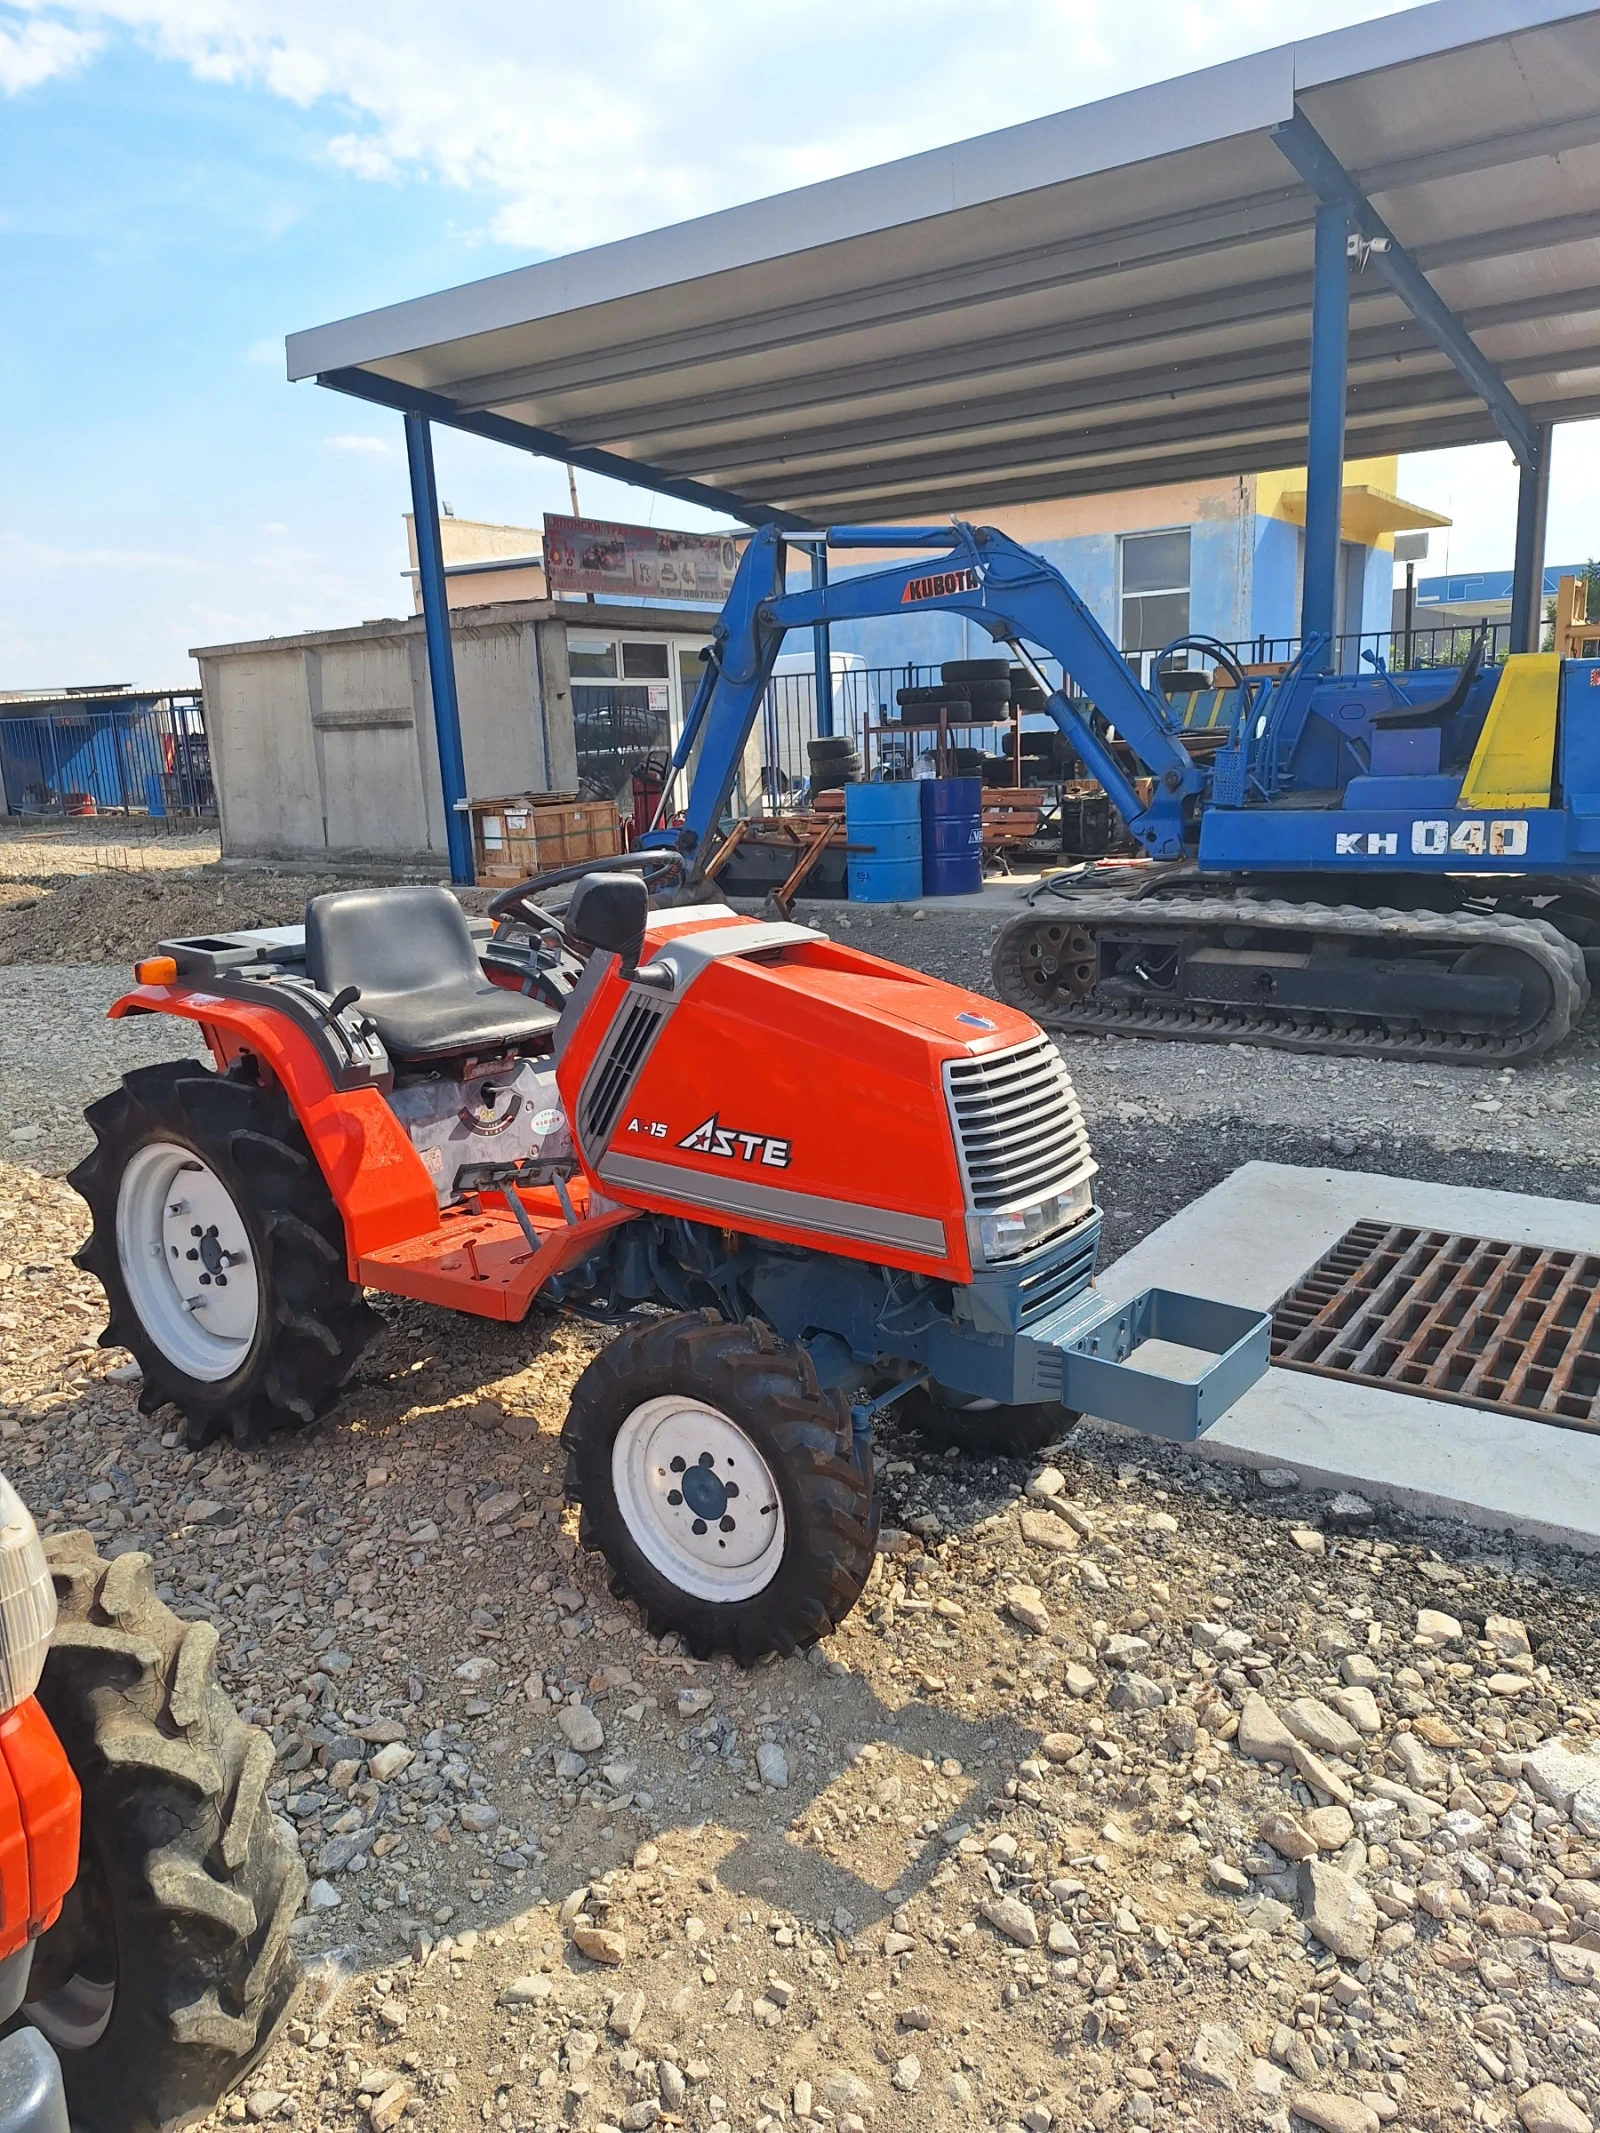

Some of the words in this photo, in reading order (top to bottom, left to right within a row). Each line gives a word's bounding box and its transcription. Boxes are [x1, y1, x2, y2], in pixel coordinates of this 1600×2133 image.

[552, 517, 602, 533] ЯПОНСКИ
[909, 569, 978, 601] KUBOTA
[1335, 833, 1398, 855] KH
[1411, 820, 1529, 856] 040
[675, 1111, 793, 1169] ASTE
